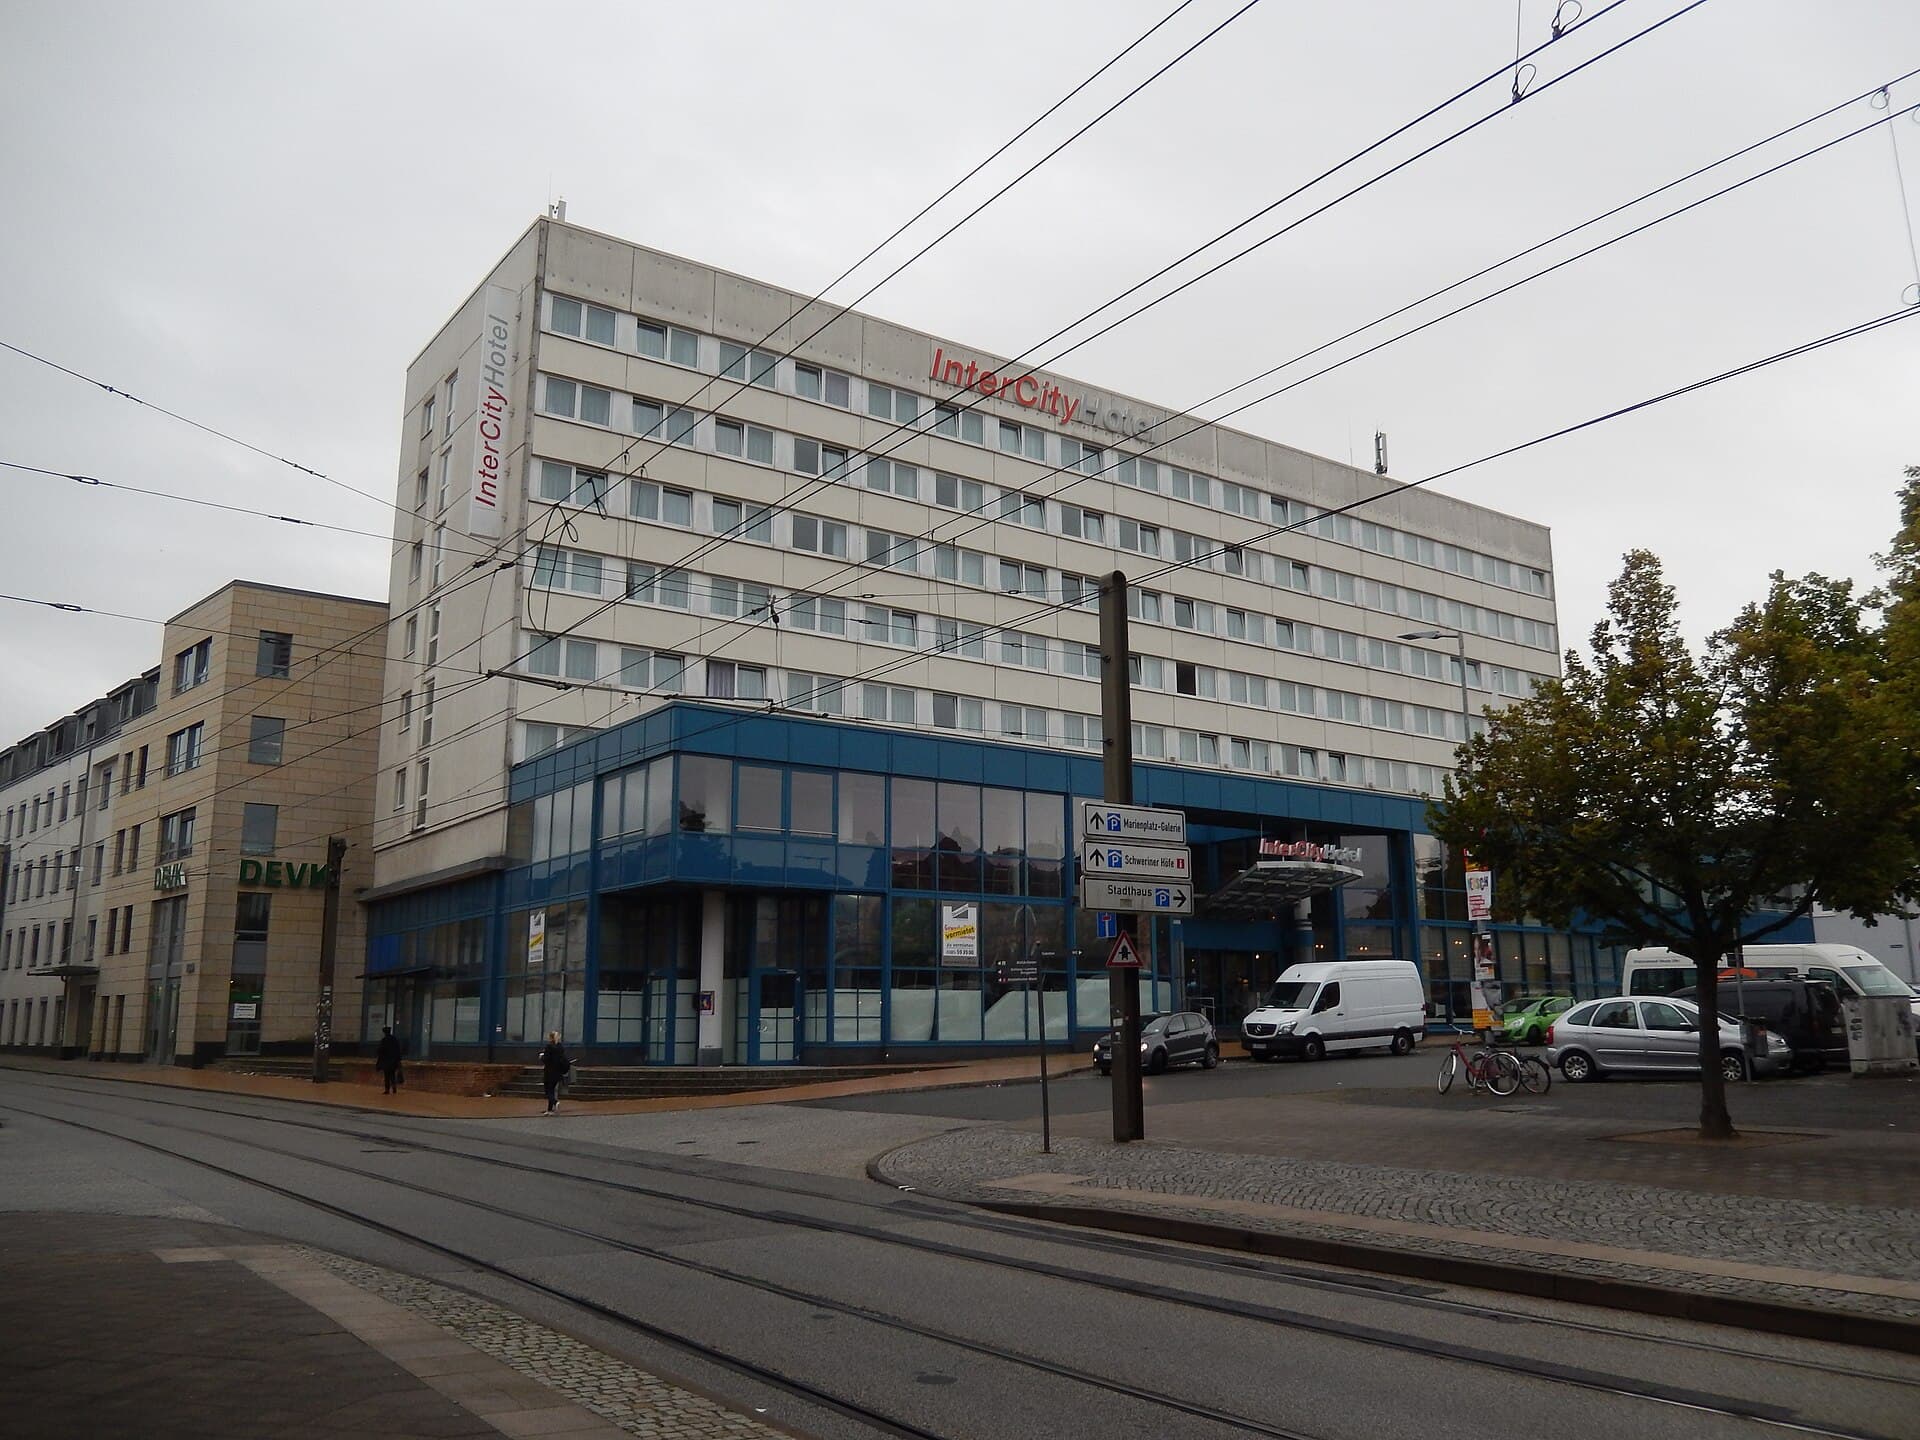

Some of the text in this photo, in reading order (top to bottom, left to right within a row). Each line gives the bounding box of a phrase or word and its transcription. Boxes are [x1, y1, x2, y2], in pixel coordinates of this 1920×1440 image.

[475, 313, 508, 508] InterCityHotel
[1123, 818, 1182, 833] Marienplatz-Galerie
[1125, 854, 1159, 867] Schweriner
[1160, 857, 1175, 868] Höfe
[1107, 885, 1153, 897] Stadthaus
